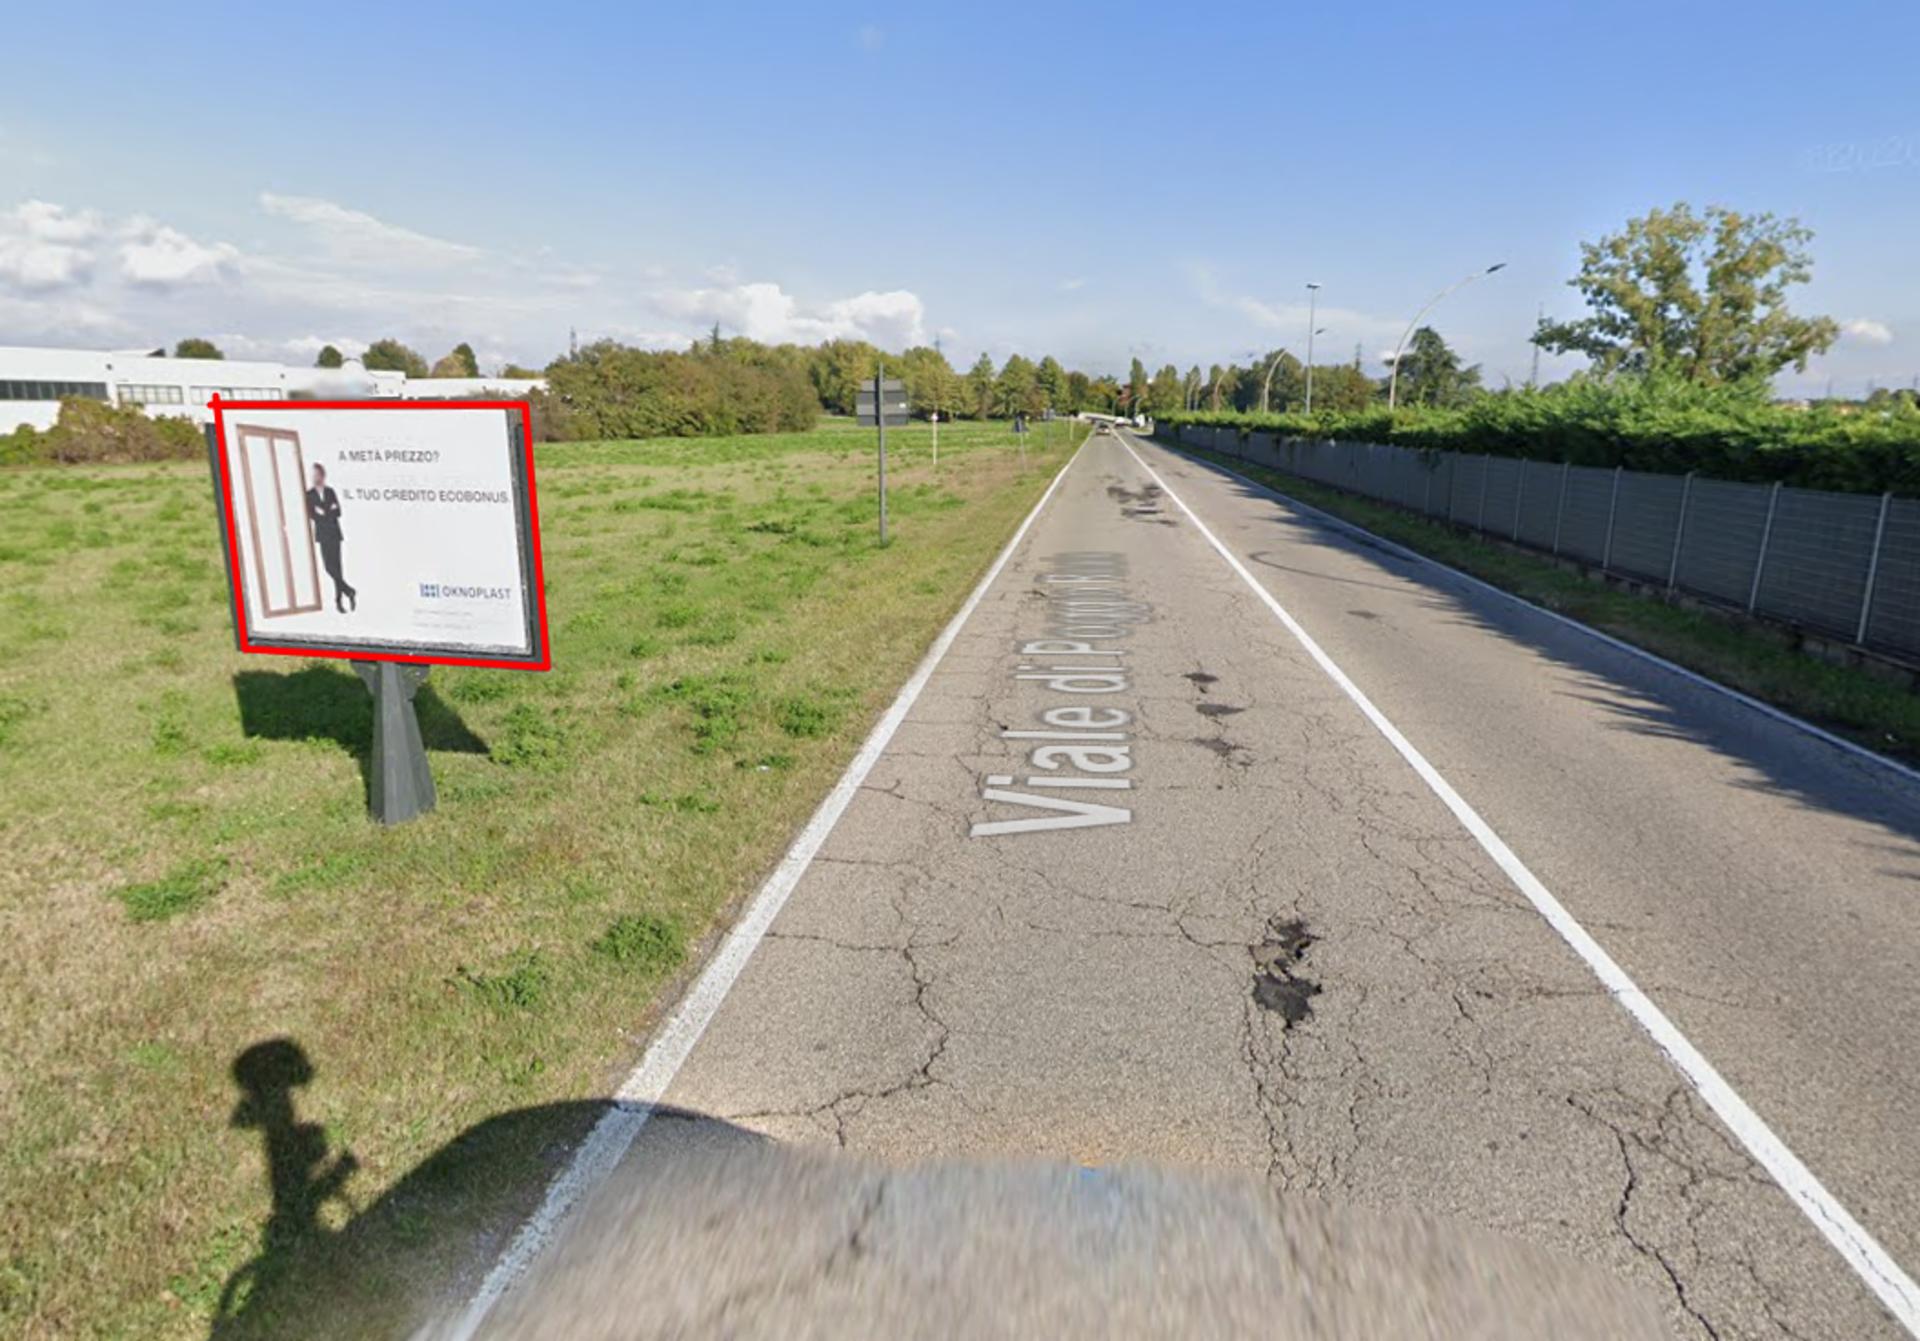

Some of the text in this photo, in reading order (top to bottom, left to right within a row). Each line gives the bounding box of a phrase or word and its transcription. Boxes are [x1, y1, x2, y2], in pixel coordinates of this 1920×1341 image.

[337, 450, 347, 461] A
[384, 450, 441, 463] PREZZO?
[356, 488, 381, 501] TUO
[382, 489, 437, 502] CREDITO
[442, 585, 512, 599] OKNOPLAST
